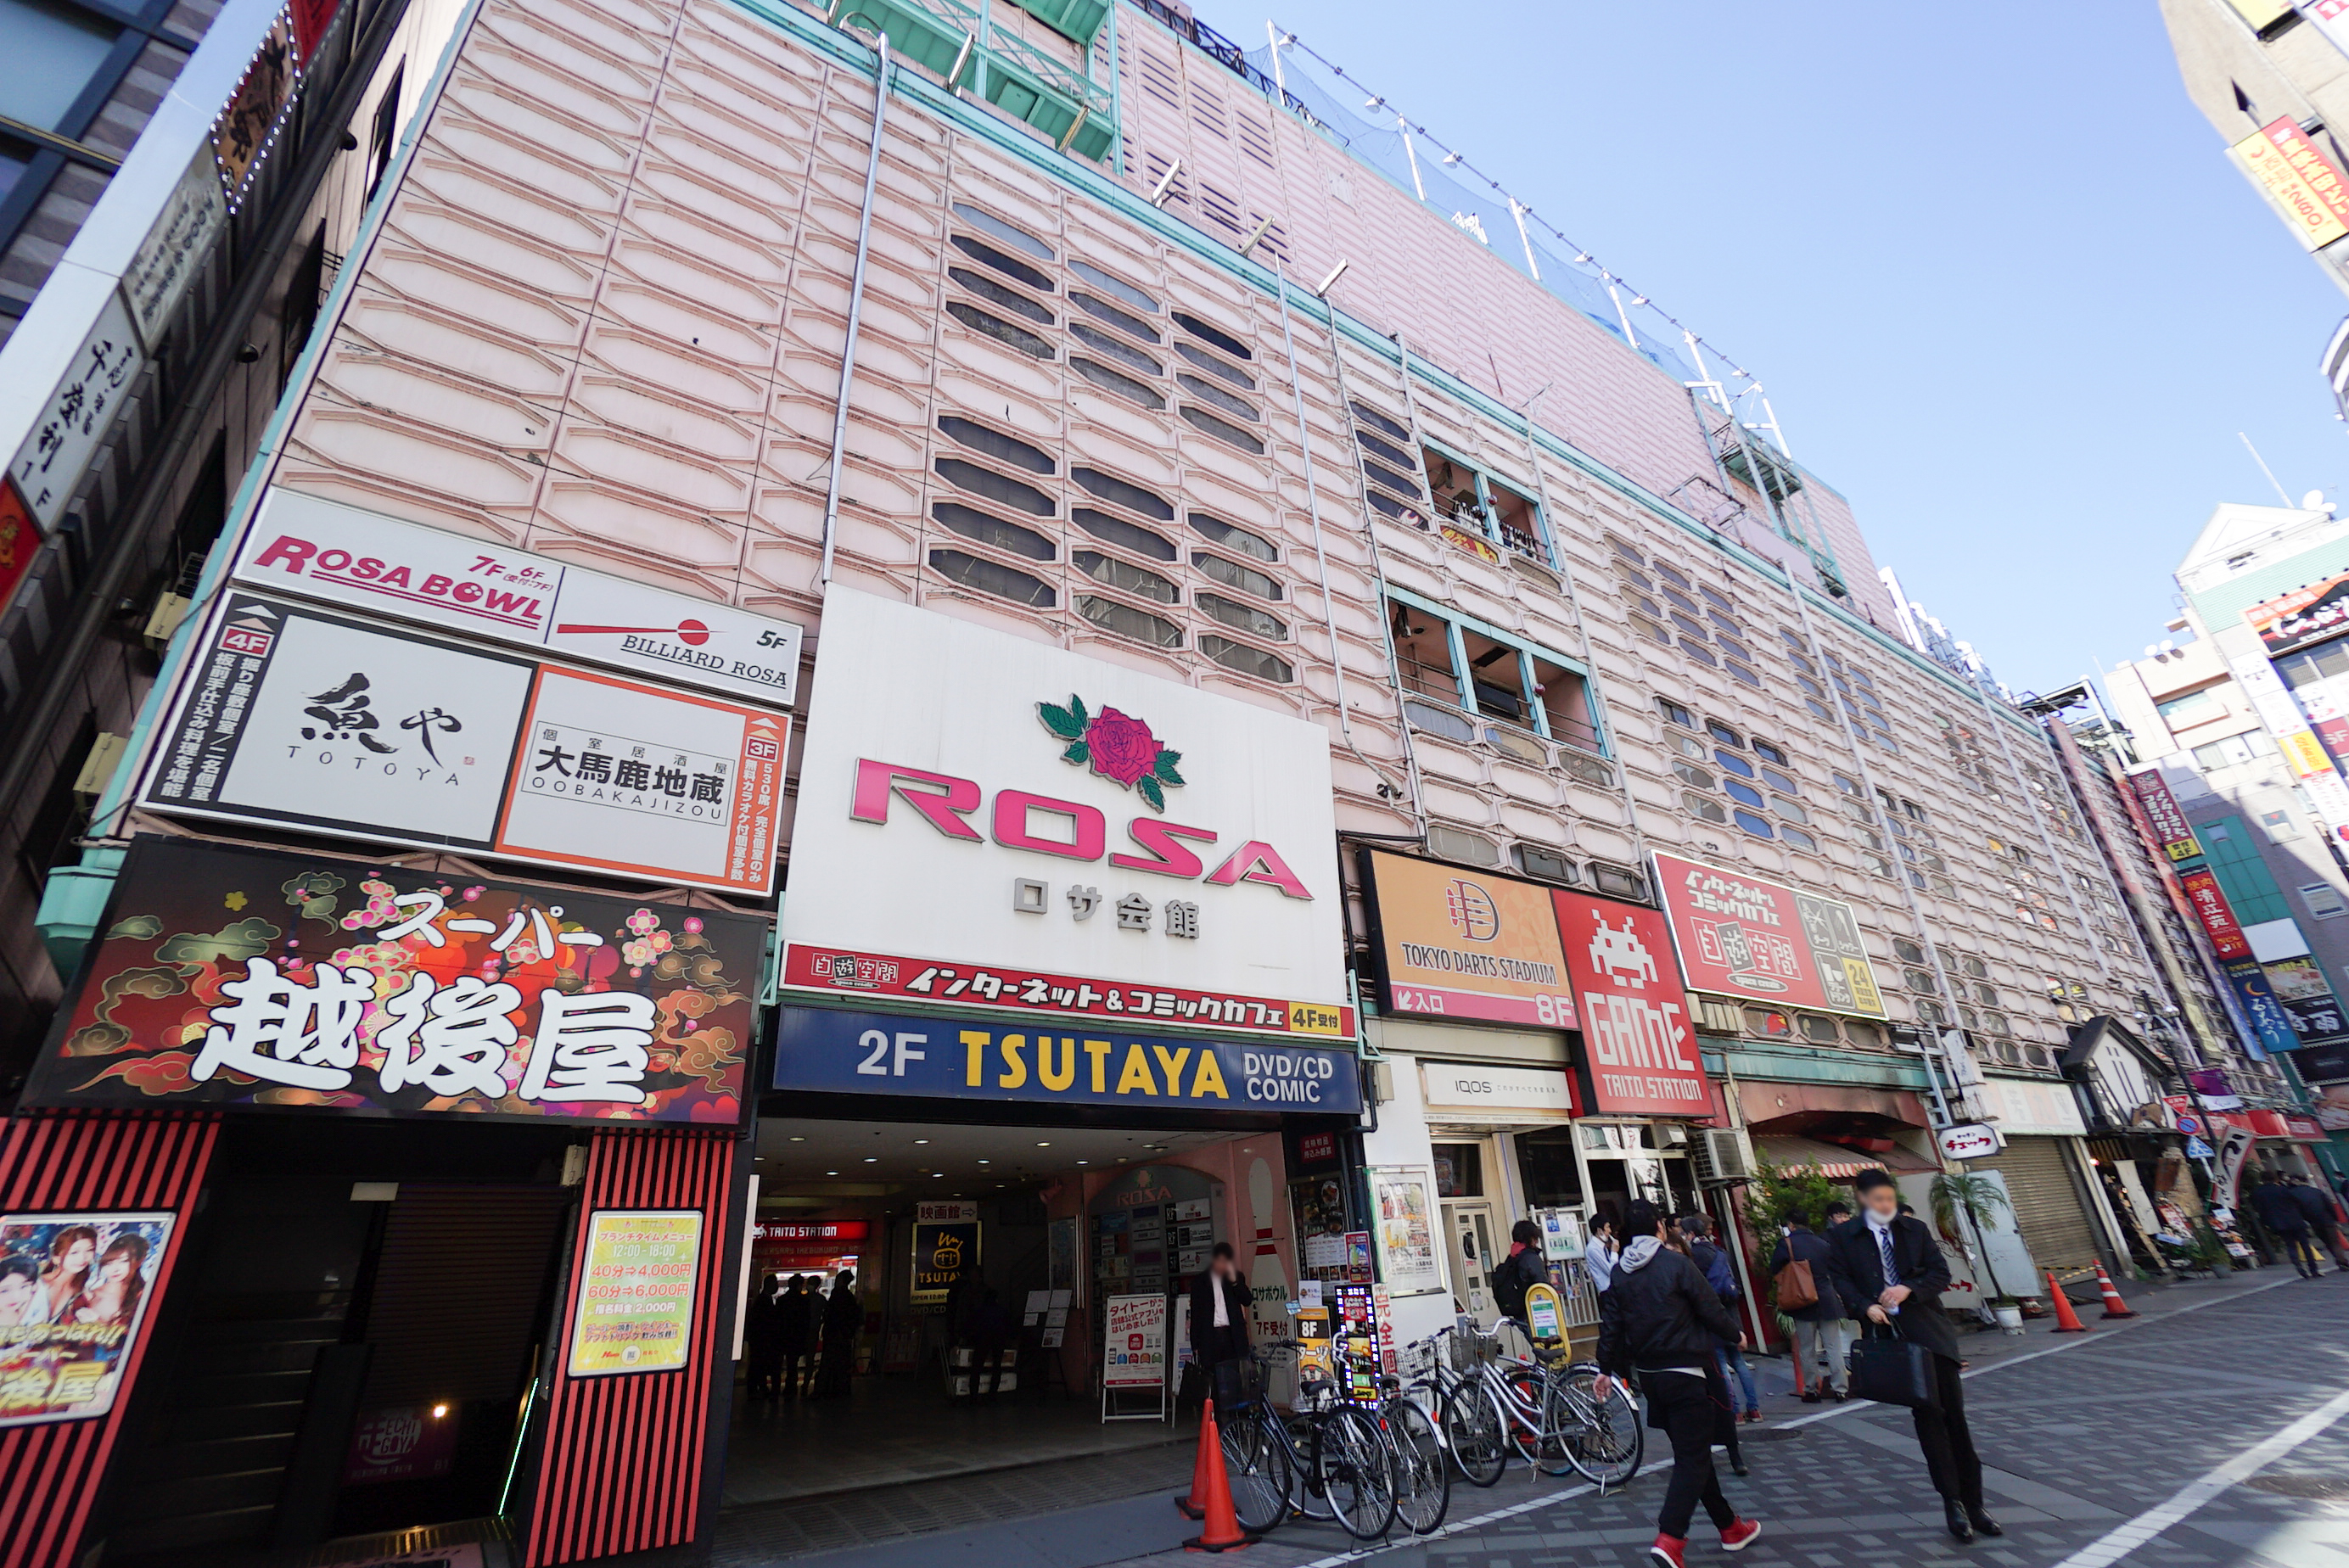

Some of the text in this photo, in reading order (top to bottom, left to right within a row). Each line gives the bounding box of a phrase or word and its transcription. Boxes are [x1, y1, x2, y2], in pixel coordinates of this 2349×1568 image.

[253, 535, 544, 620] ROSA BOWL
[468, 555, 547, 580] 7F 6F
[226, 633, 268, 653] 4F
[756, 630, 788, 650] 5F
[621, 635, 788, 686] BILLIARD ROSA
[300, 672, 463, 769] 魚や
[287, 745, 459, 787] TOTOYA
[542, 728, 728, 776] 個室居酒屋
[750, 742, 776, 758] 3F
[535, 745, 726, 805] 大馬鹿地蔵
[532, 776, 721, 820] OOBAKAJIZOU
[730, 759, 758, 882] 無料カラオケ付個室多数
[849, 757, 1315, 901] ROSA
[1013, 877, 1200, 939] ロサ会館
[1688, 889, 1781, 927] コミックカフェ
[376, 892, 605, 960] スーパー
[1400, 942, 1559, 987] TOKYO DARTS STADIUM
[1697, 923, 1797, 976] 自遊空間
[812, 954, 899, 983] 自遊空間
[1416, 991, 1444, 1014] 入口
[1534, 992, 1574, 1027] 8F
[191, 958, 657, 1105] 越後屋
[1583, 991, 1696, 1072] GAME
[856, 1028, 1230, 1100] 2F TSUTAYA
[1244, 1052, 1333, 1079] DVD/CD
[1246, 1077, 1321, 1103] COMIC
[1455, 1079, 1493, 1095] IQOS
[1602, 1074, 1704, 1102] TAITO STATION
[1945, 1137, 1992, 1151] チェック
[920, 1204, 961, 1220] 映画館
[1115, 1185, 1174, 1207] ROSA
[599, 1232, 694, 1242] ブランチタイムメニュー
[769, 1225, 838, 1237] TAITO STATION
[919, 1271, 961, 1283] TSUTA
[1252, 1285, 1288, 1302] ロサボウル
[1301, 1321, 1317, 1337] 8F
